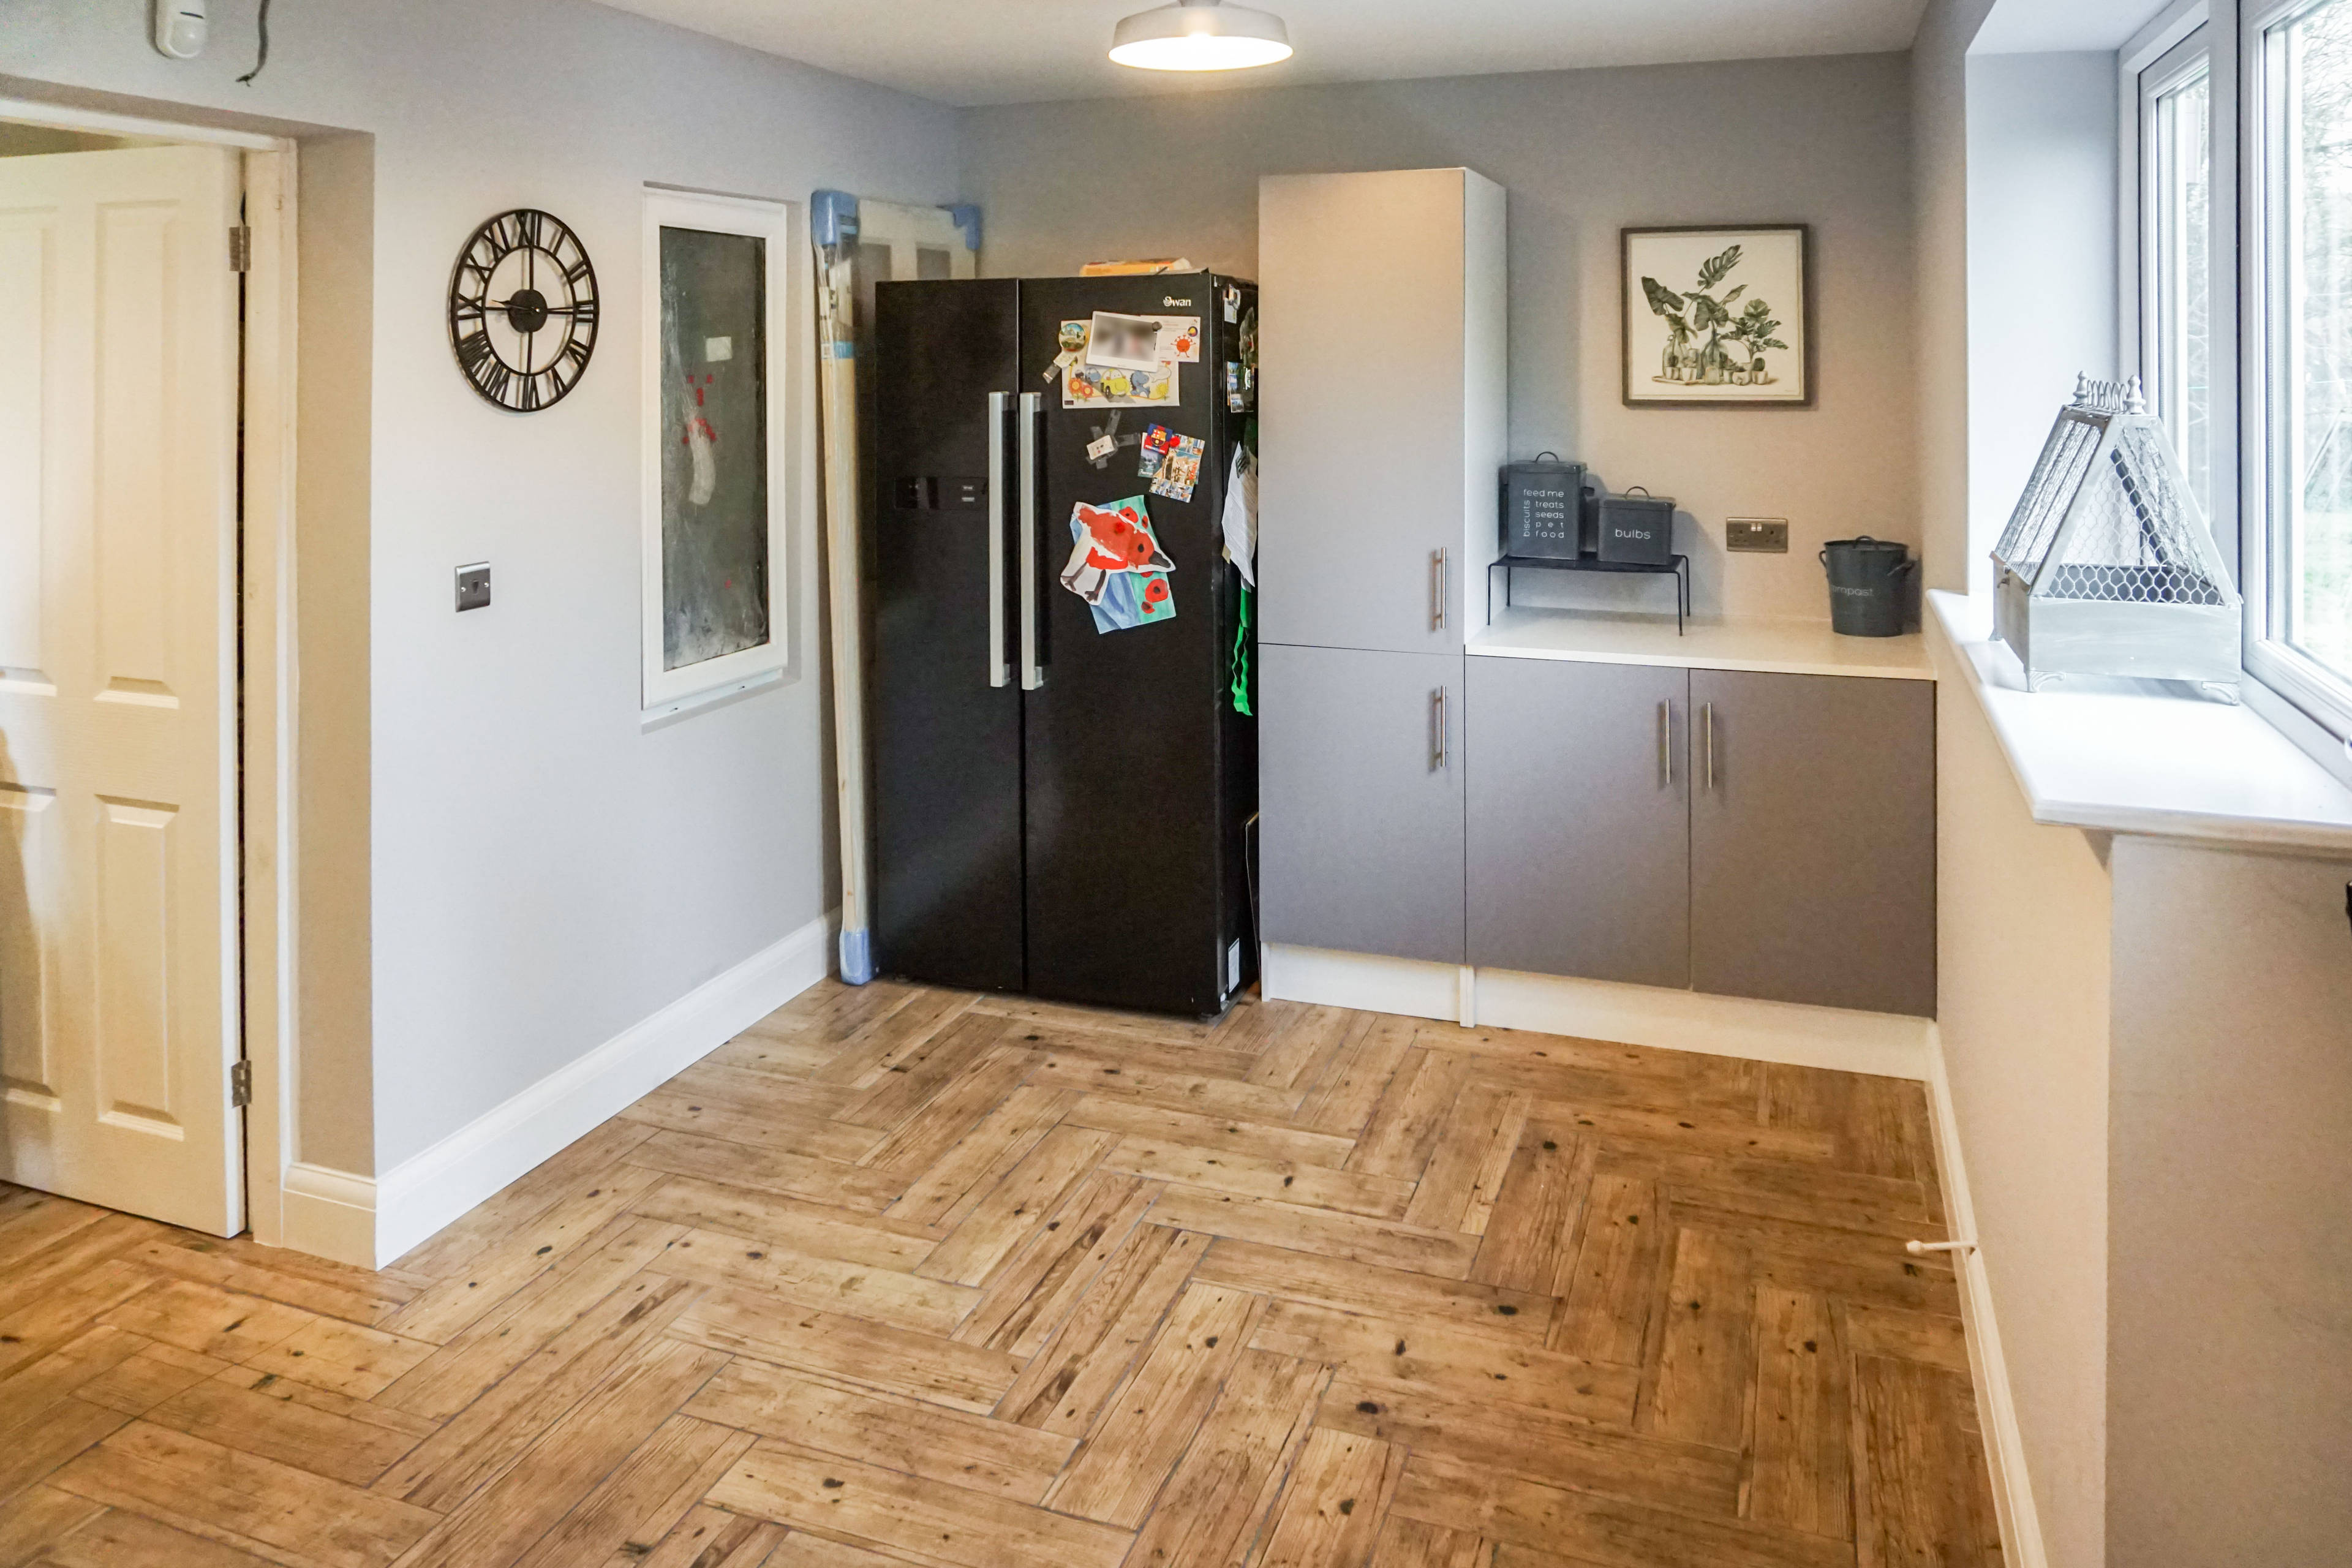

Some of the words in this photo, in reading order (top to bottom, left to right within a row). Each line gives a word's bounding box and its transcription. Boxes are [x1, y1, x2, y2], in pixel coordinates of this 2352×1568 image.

[1523, 489, 1545, 497] feed
[1536, 530, 1564, 538] food
[1615, 528, 1651, 540] bulbs
